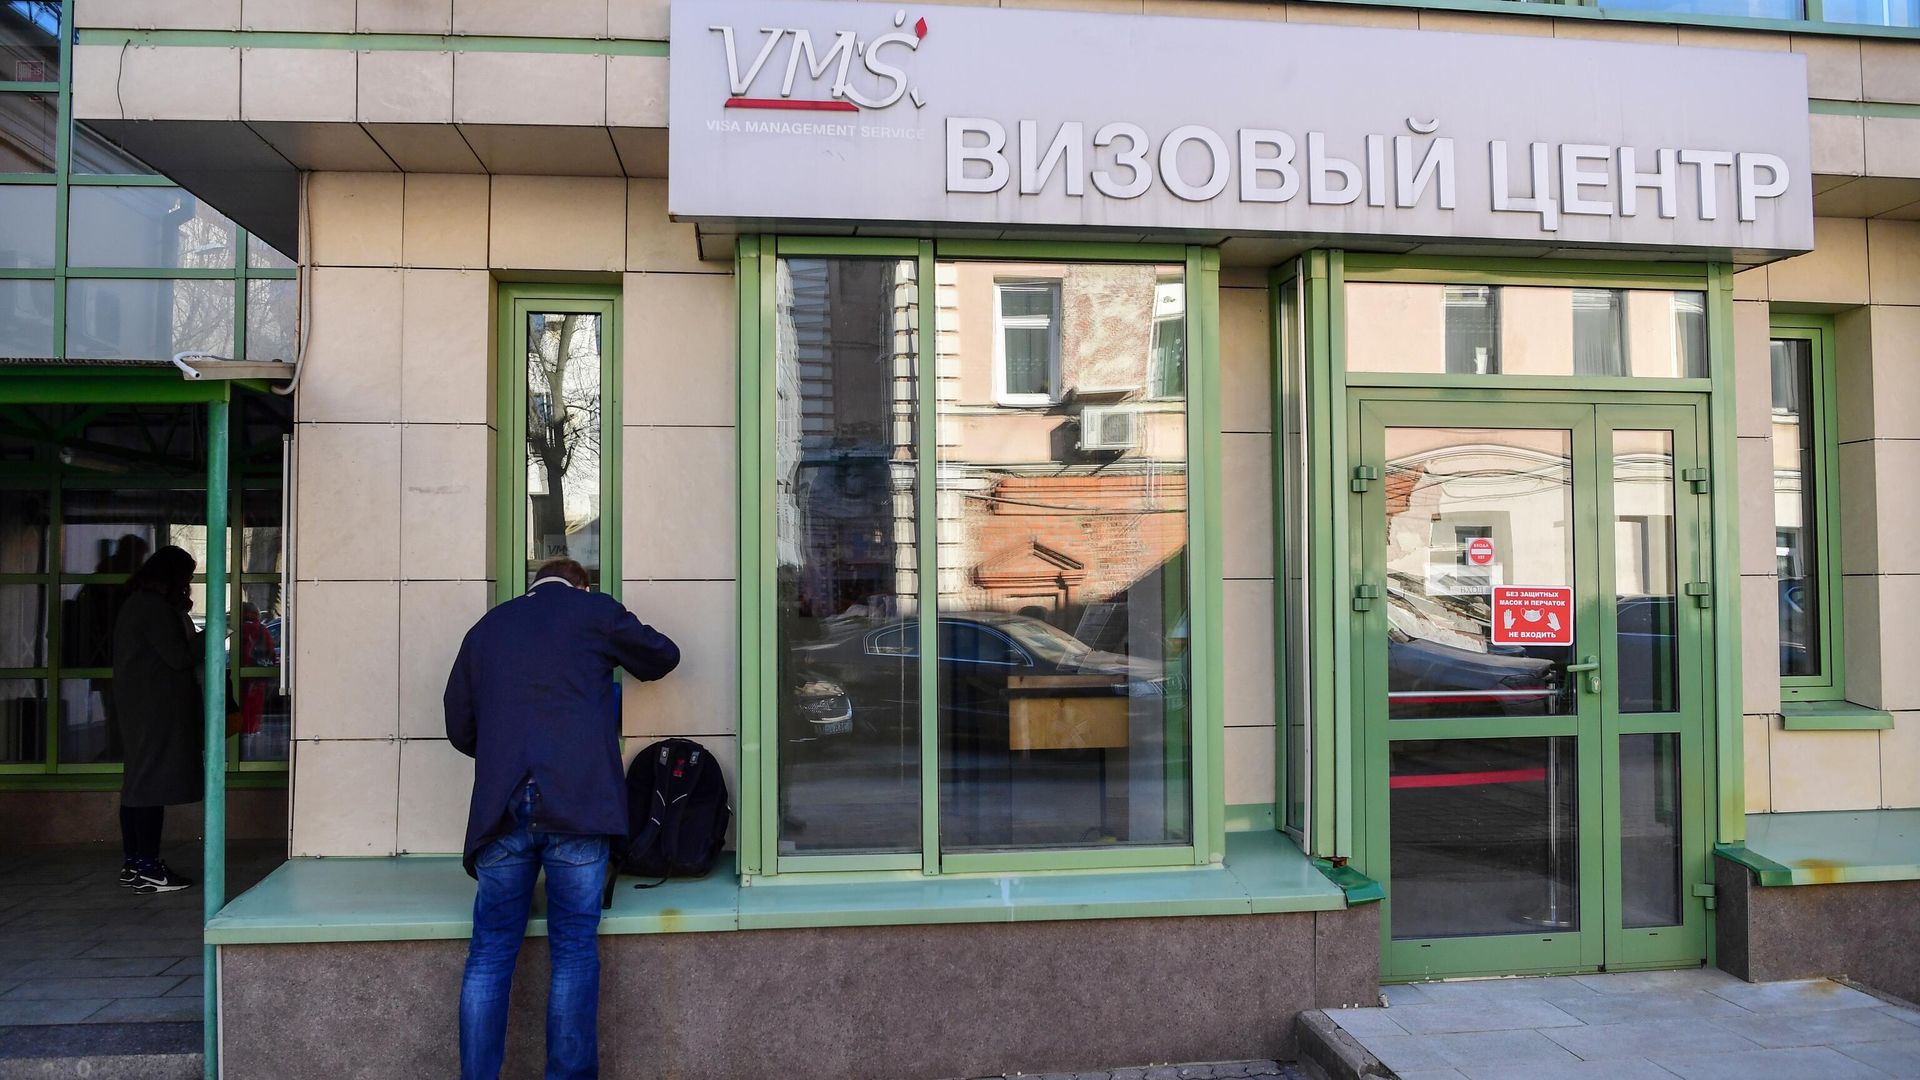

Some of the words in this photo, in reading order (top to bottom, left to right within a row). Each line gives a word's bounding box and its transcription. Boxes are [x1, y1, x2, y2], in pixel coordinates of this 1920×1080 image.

[706, 119, 741, 133] VISA
[744, 121, 856, 137] MANAGEMENT
[861, 126, 926, 140] SERVICE
[945, 116, 1455, 210] ВИЗОВЫЙ
[1490, 139, 1791, 231] ЦЕНТР
[1520, 631, 1557, 639] ВХОДИТЬ
